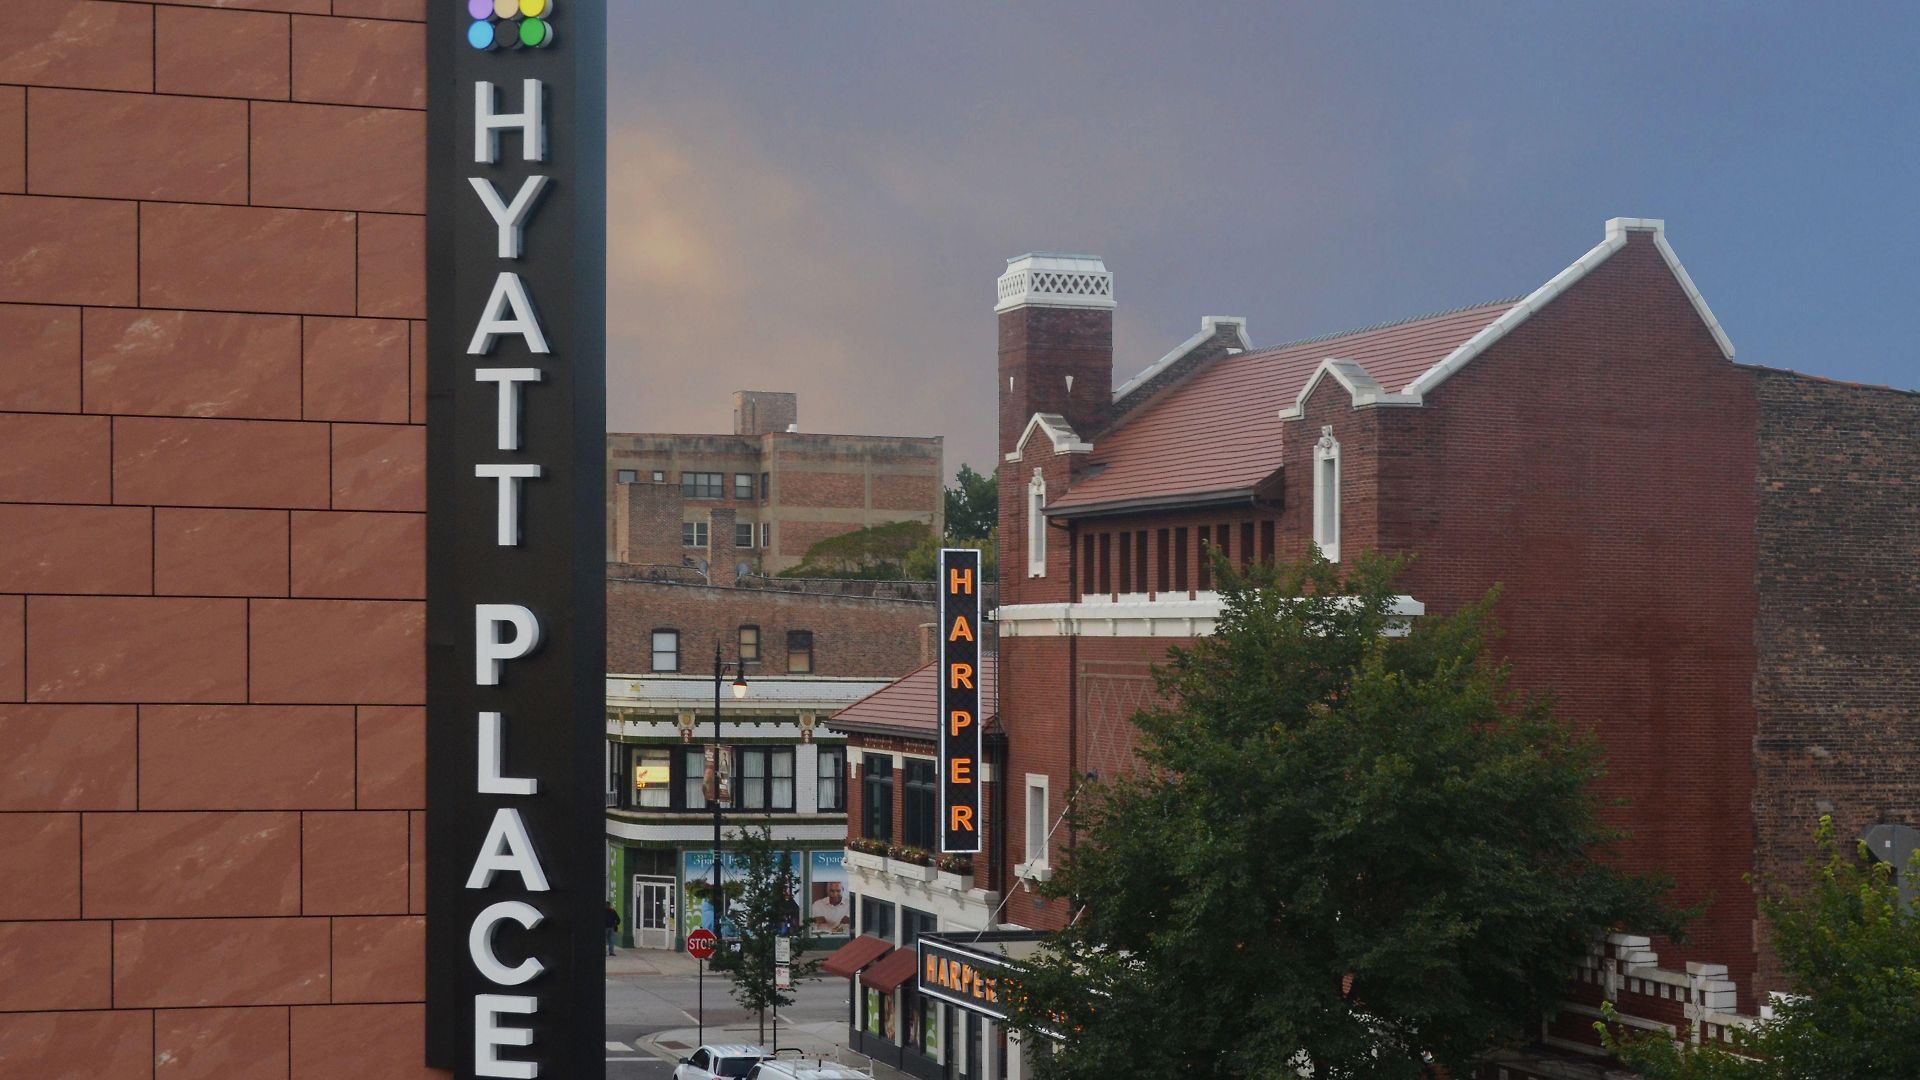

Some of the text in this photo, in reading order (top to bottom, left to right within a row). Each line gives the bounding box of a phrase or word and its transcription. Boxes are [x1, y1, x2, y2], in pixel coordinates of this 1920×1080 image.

[466, 79, 551, 1080] HYATT PLACE
[949, 568, 974, 832] HARPER
